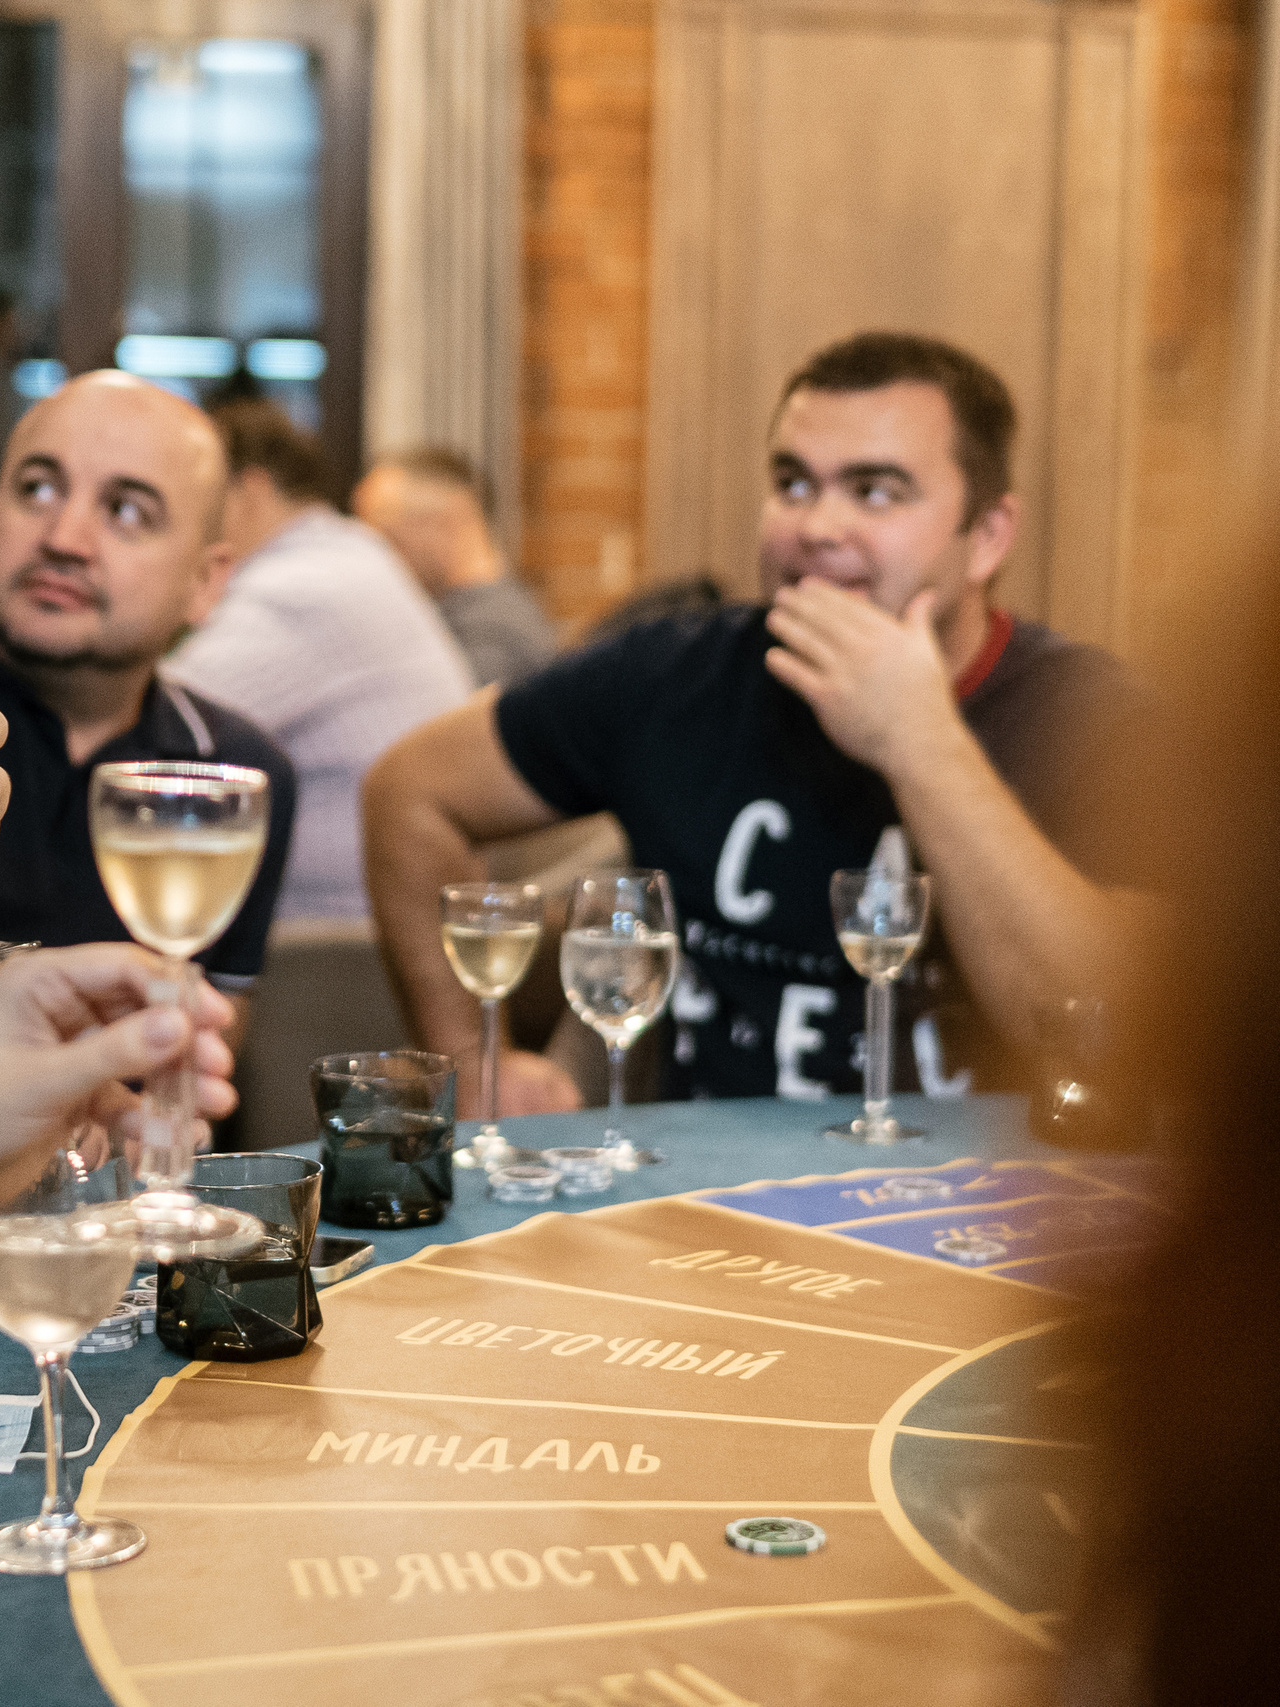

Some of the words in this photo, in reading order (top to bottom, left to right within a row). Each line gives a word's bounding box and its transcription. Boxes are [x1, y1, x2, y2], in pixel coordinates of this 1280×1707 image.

[650, 1249, 883, 1298] ДРУГОЕ
[397, 1316, 786, 1380] ЦВЕТОЧНЫЙ
[306, 1430, 662, 1475] МИНДАЛЬ
[288, 1541, 708, 1600] ПРЯНОСТИ
